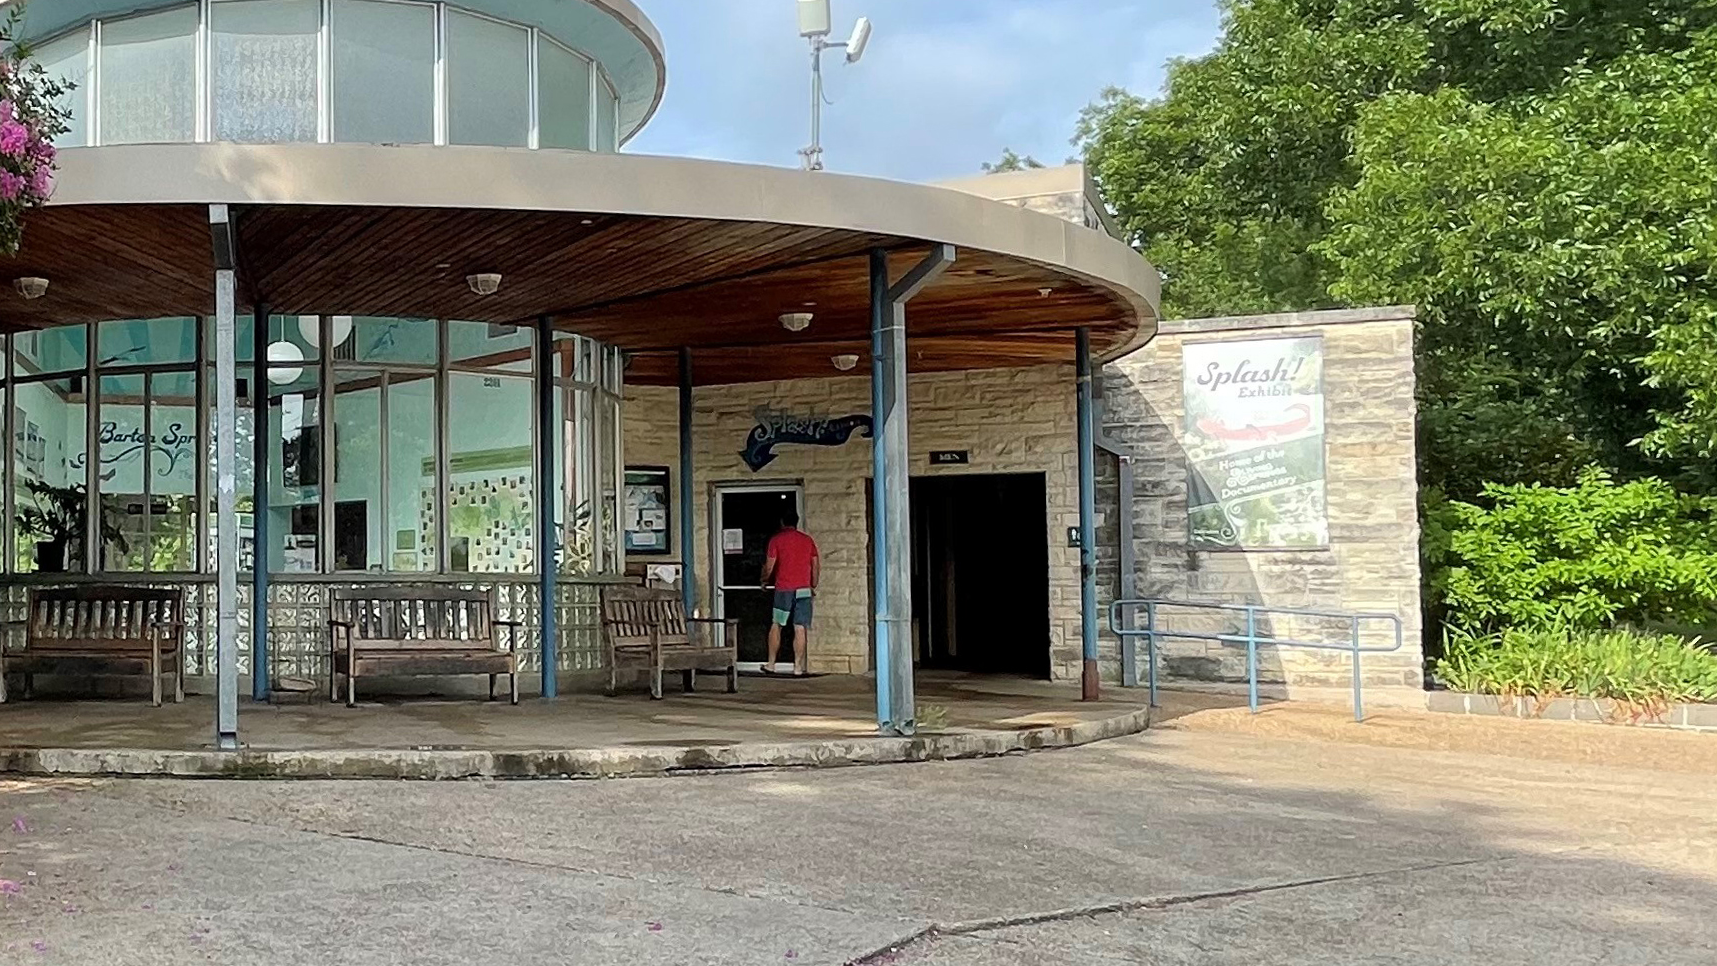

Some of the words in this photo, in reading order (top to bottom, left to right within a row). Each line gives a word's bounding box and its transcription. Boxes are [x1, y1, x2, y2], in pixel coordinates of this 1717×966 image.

[1196, 357, 1305, 391] Splash!
[1238, 384, 1292, 398] Exhibit
[100, 422, 156, 444] Barton
[1218, 457, 1252, 471] Home
[1253, 450, 1266, 463] of
[1266, 448, 1285, 460] the
[1221, 476, 1297, 500] Documentary
